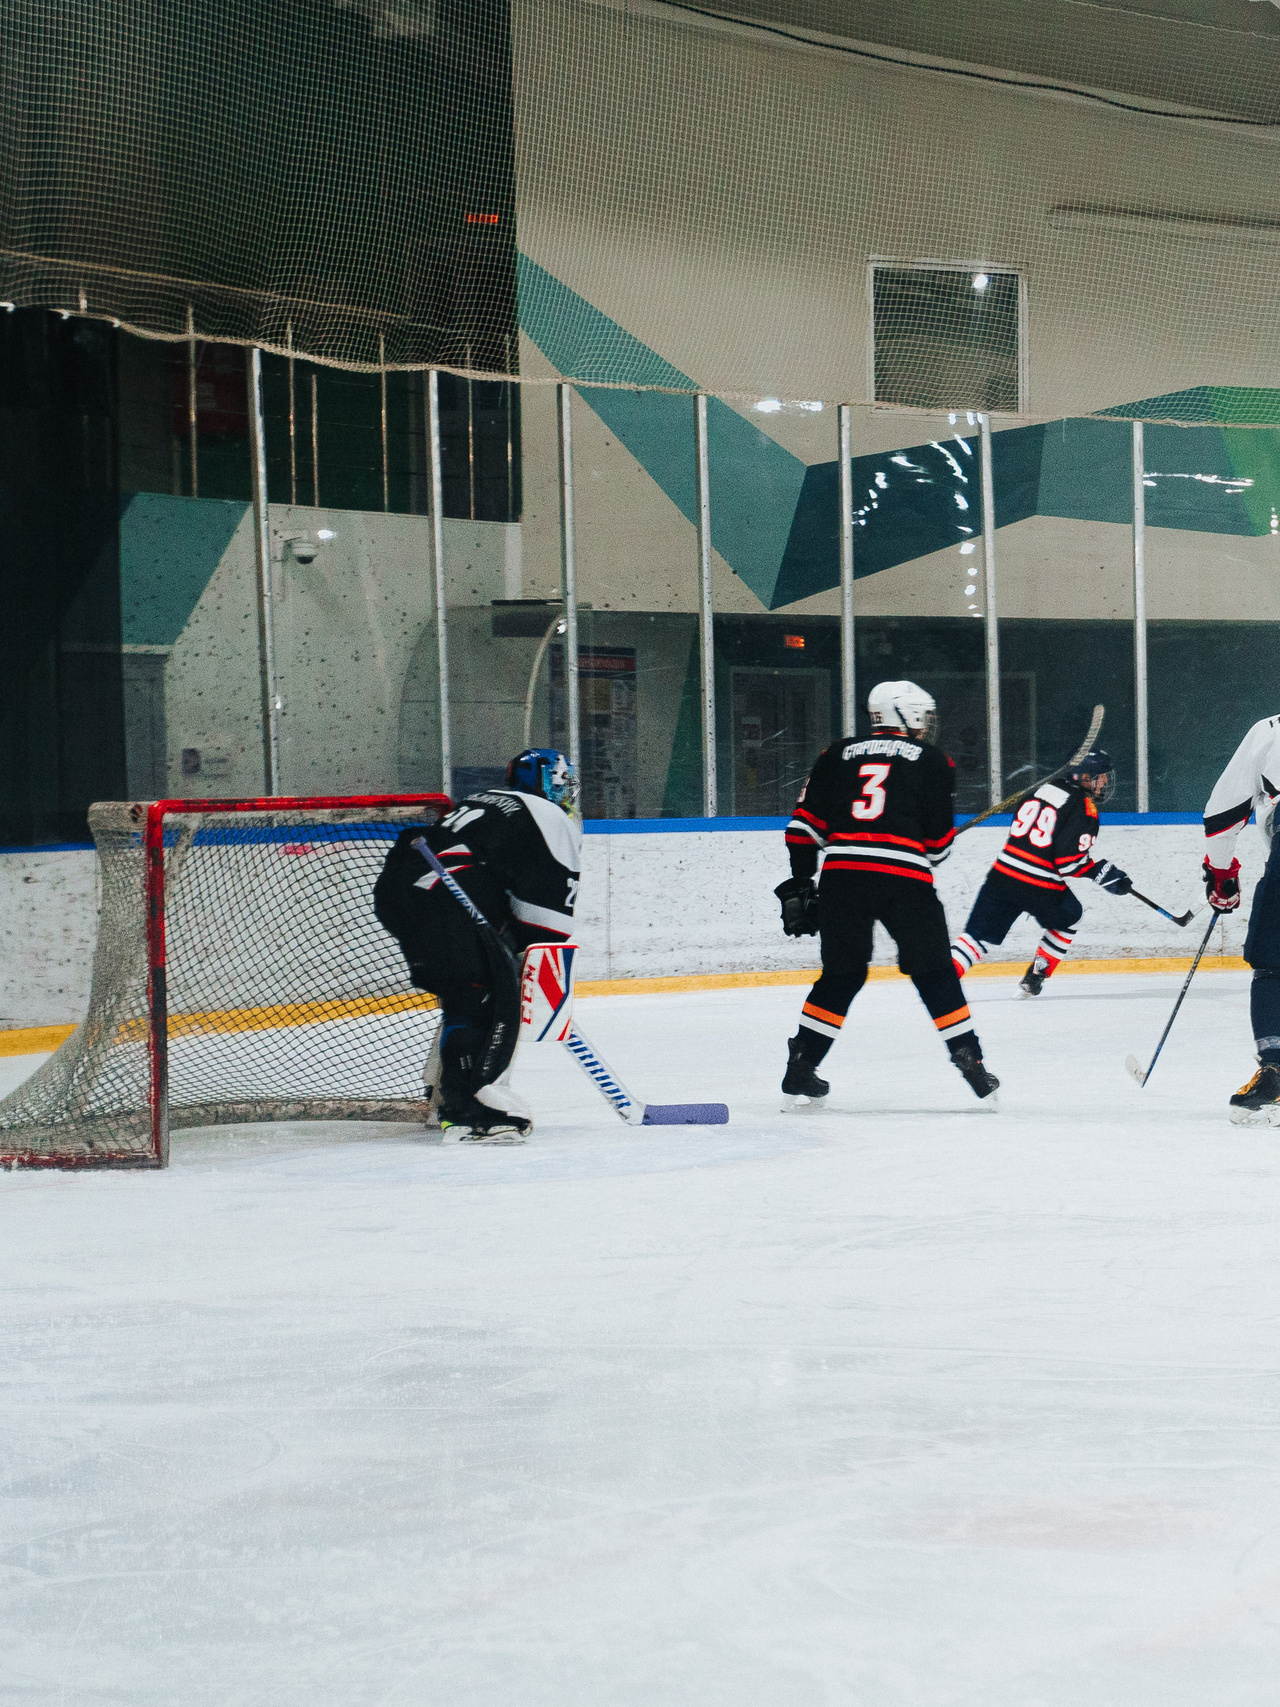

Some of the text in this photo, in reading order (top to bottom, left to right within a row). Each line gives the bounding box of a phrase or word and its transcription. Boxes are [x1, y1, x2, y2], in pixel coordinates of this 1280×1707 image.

[851, 763, 891, 821] 3
[1010, 799, 1057, 848] 99
[520, 964, 536, 1025] CCM
